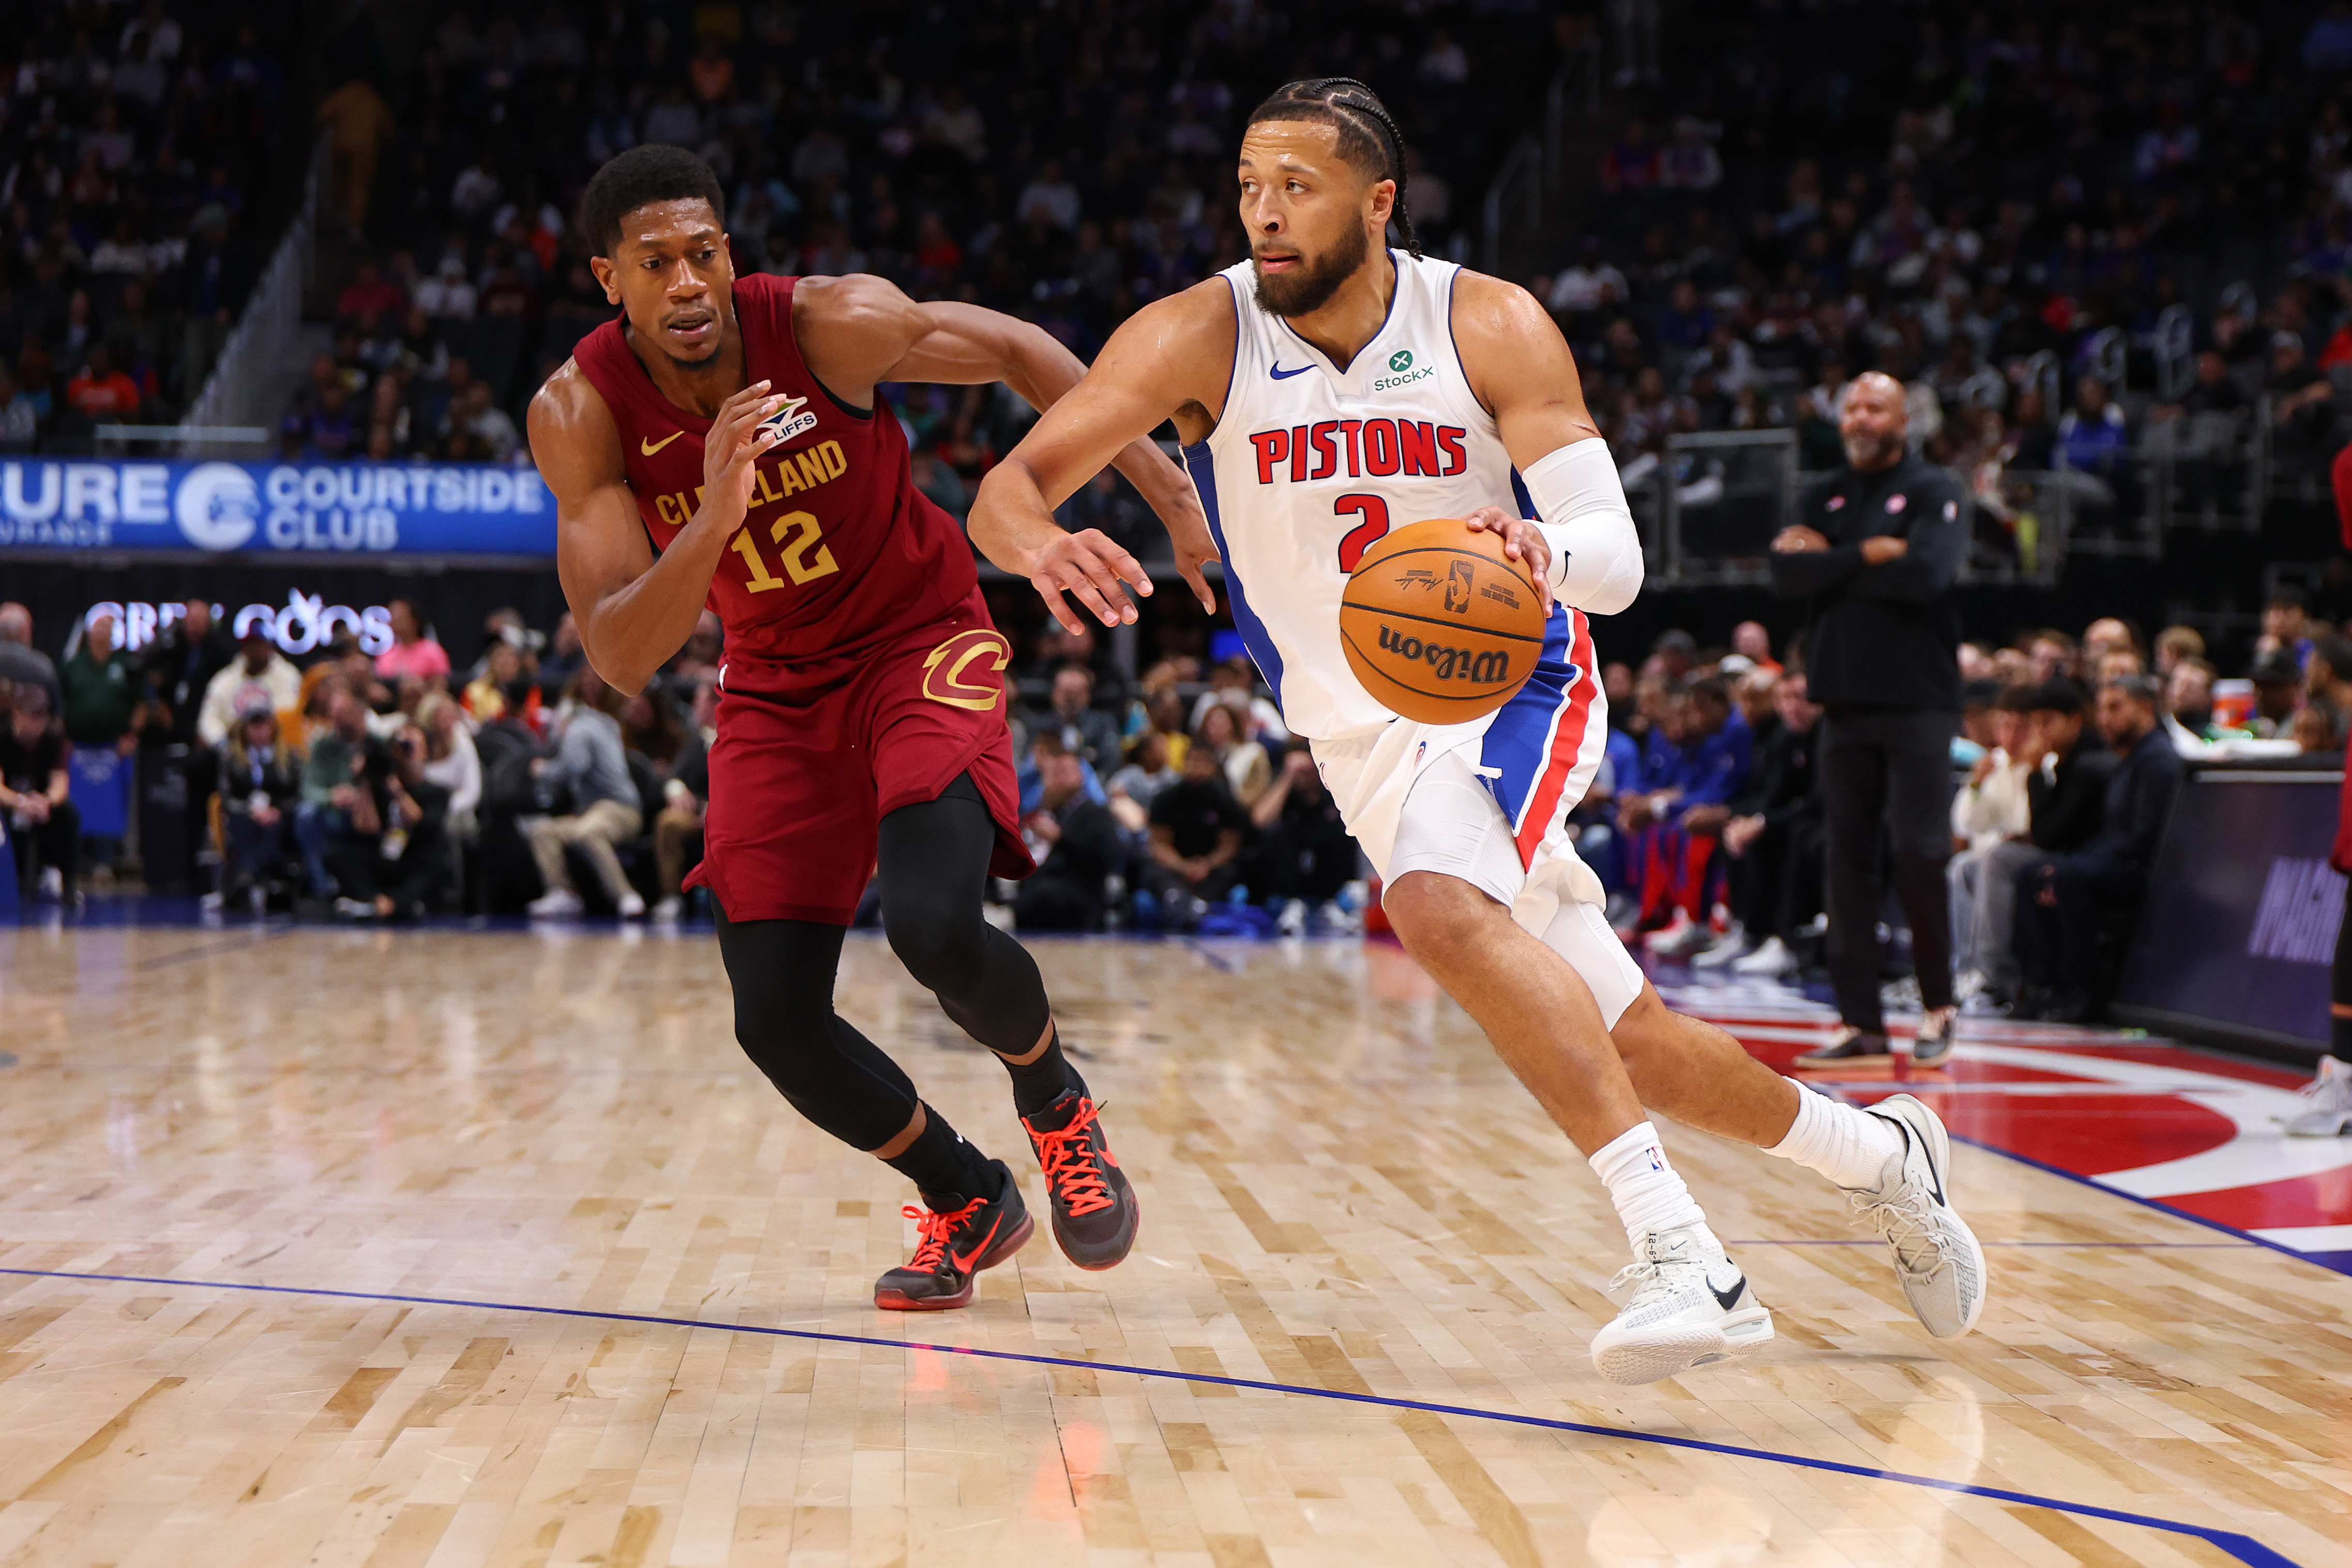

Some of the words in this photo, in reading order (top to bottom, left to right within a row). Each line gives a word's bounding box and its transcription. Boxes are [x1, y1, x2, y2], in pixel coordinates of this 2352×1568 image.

[1374, 366, 1434, 391] StockX
[774, 415, 815, 440] LIFFS
[1249, 418, 1467, 484] PISTONS
[0, 462, 170, 524] URE
[266, 465, 544, 514] COURTSIDE
[655, 439, 848, 525] CLLAND
[265, 506, 399, 550] CLUB
[730, 510, 840, 594] 12
[1334, 493, 1390, 574] 2
[233, 593, 395, 656] GOOS
[1378, 624, 1510, 683] Wilson
